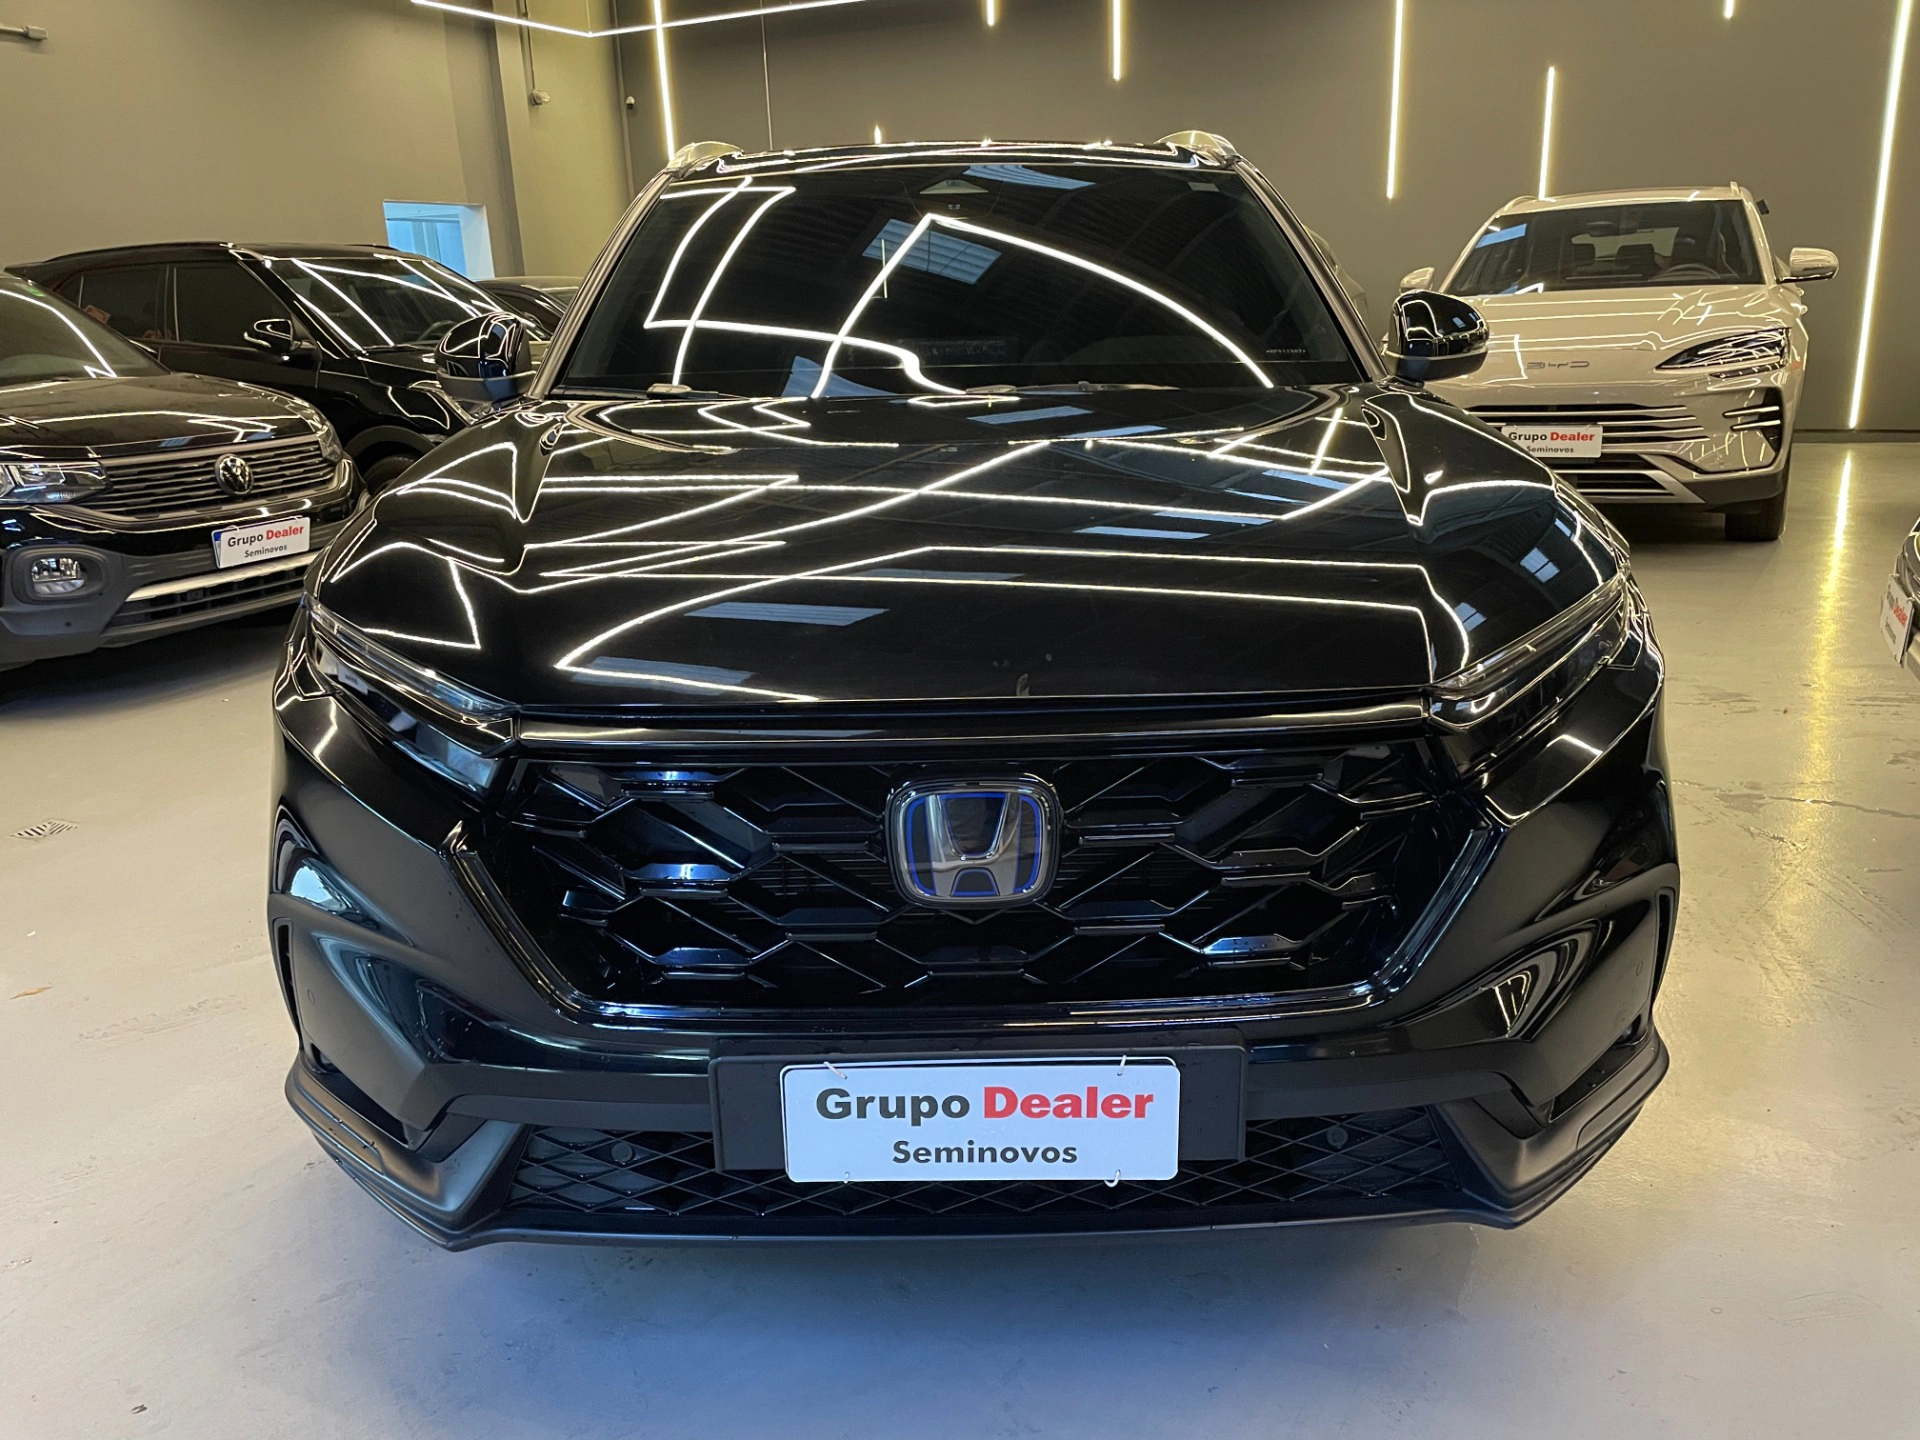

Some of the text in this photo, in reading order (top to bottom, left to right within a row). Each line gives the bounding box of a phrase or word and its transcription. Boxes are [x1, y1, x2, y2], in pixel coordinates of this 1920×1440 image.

[1527, 361, 1590, 369] BYD
[1508, 432, 1595, 443] Grupo Dealer
[228, 526, 304, 548] Grupo Dealer
[244, 544, 288, 558] Seminovos
[816, 1086, 1154, 1126] Grupo Dealer
[892, 1139, 1078, 1164] Seminovos
